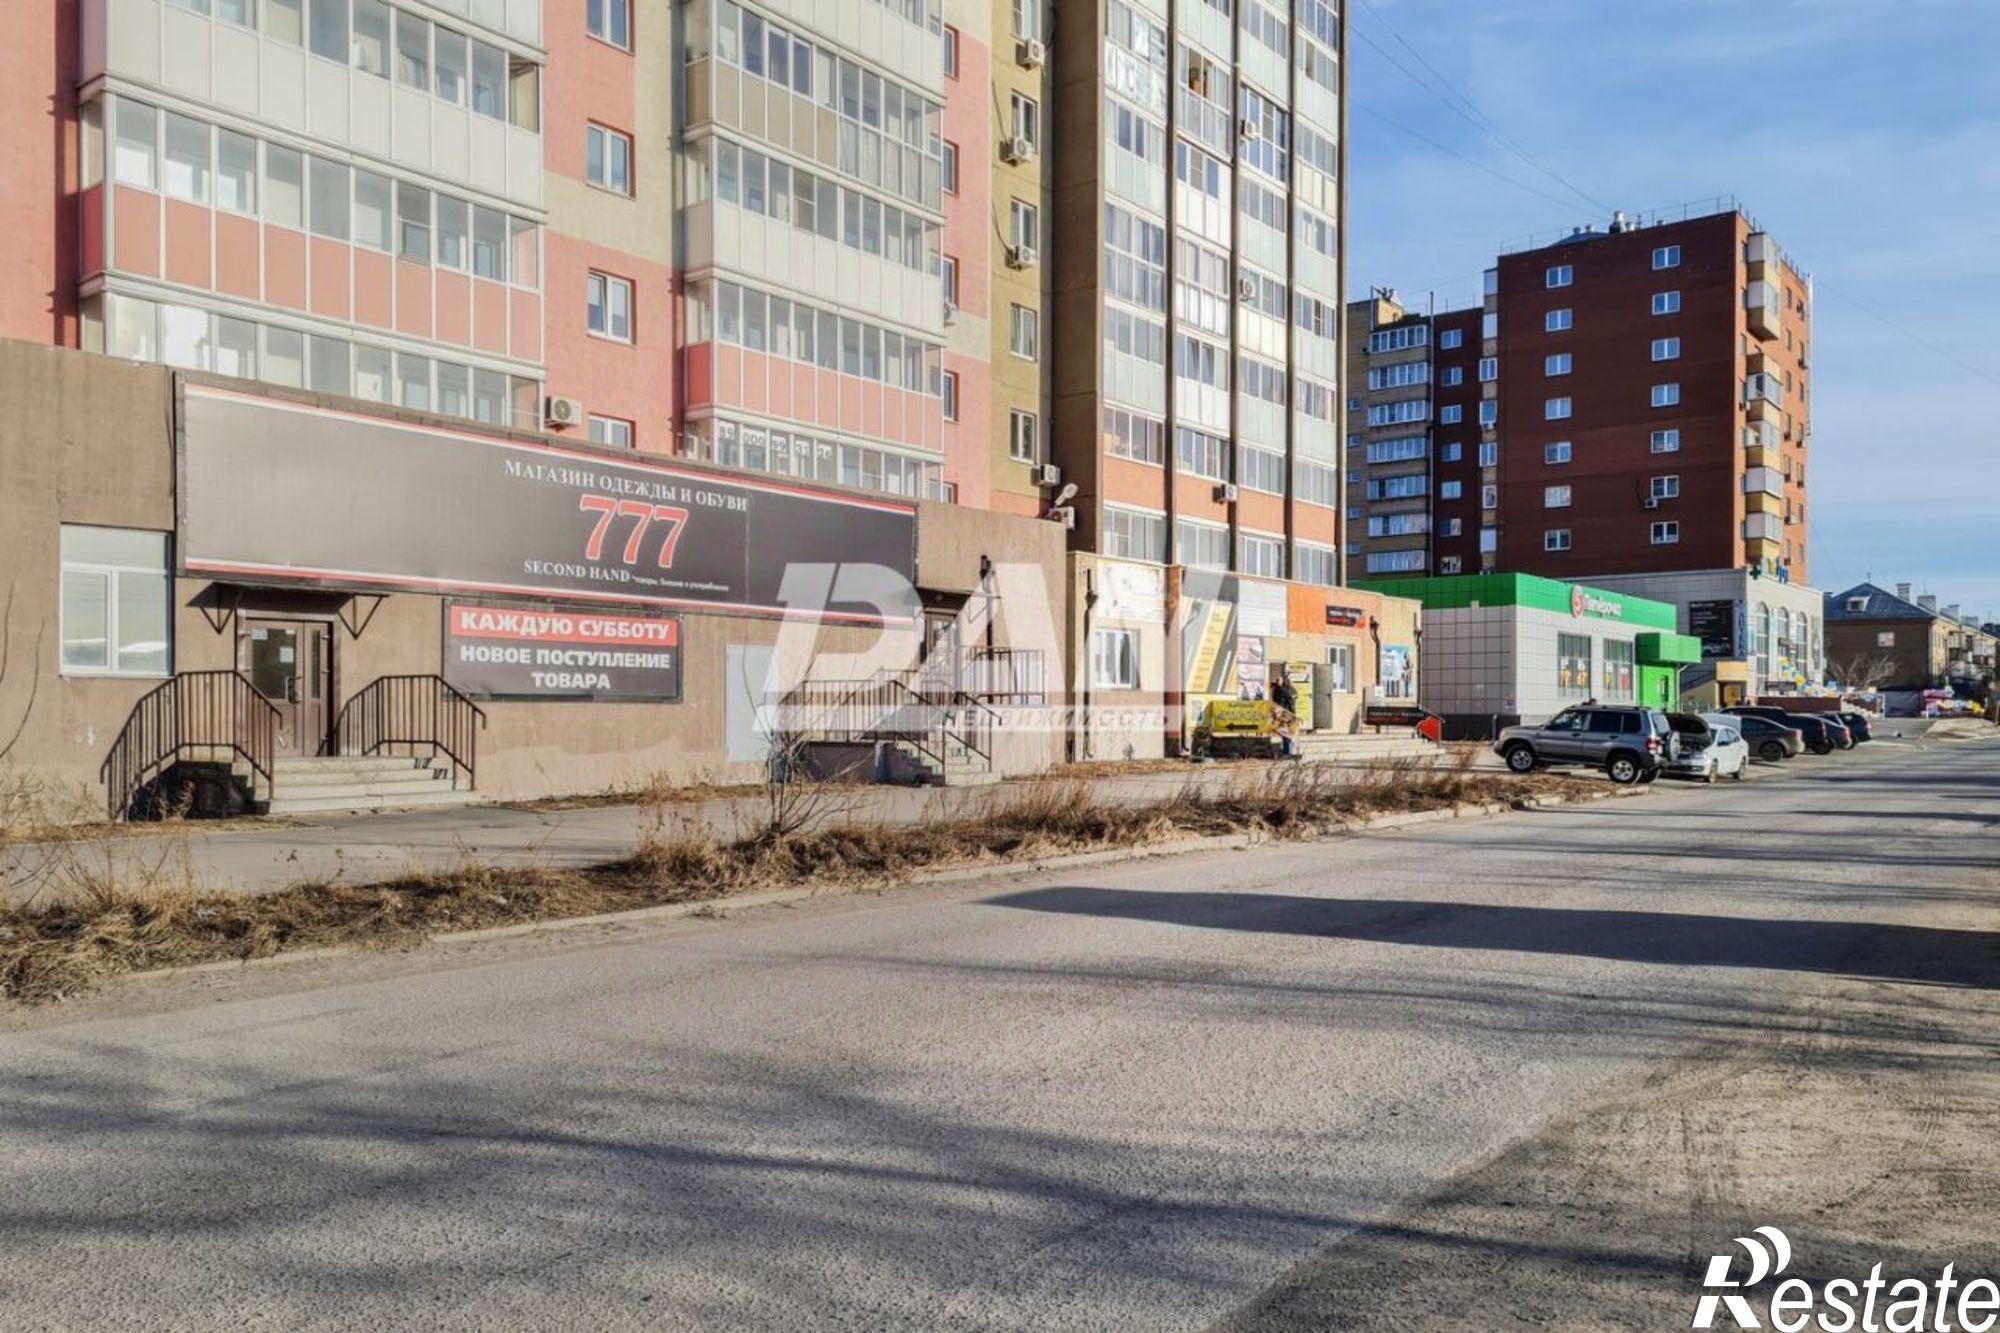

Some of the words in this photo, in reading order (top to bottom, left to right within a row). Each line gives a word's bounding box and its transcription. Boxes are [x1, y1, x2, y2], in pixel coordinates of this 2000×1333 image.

[504, 459, 595, 488] МАГАЗИН
[599, 474, 676, 501] ОДЕЖДЫ
[680, 488, 692, 503] И
[696, 491, 747, 512] ОБУВИ
[579, 493, 690, 568] 777
[524, 558, 587, 578] SECOND
[589, 567, 630, 583] HAND
[461, 611, 573, 635] КАЖДУЮ
[578, 618, 670, 640] СУББОТУ
[460, 645, 531, 664] НОВОЕ
[536, 648, 670, 669] ПОСТУПЛЕНИЕ
[531, 671, 611, 689] ТОВАРА
